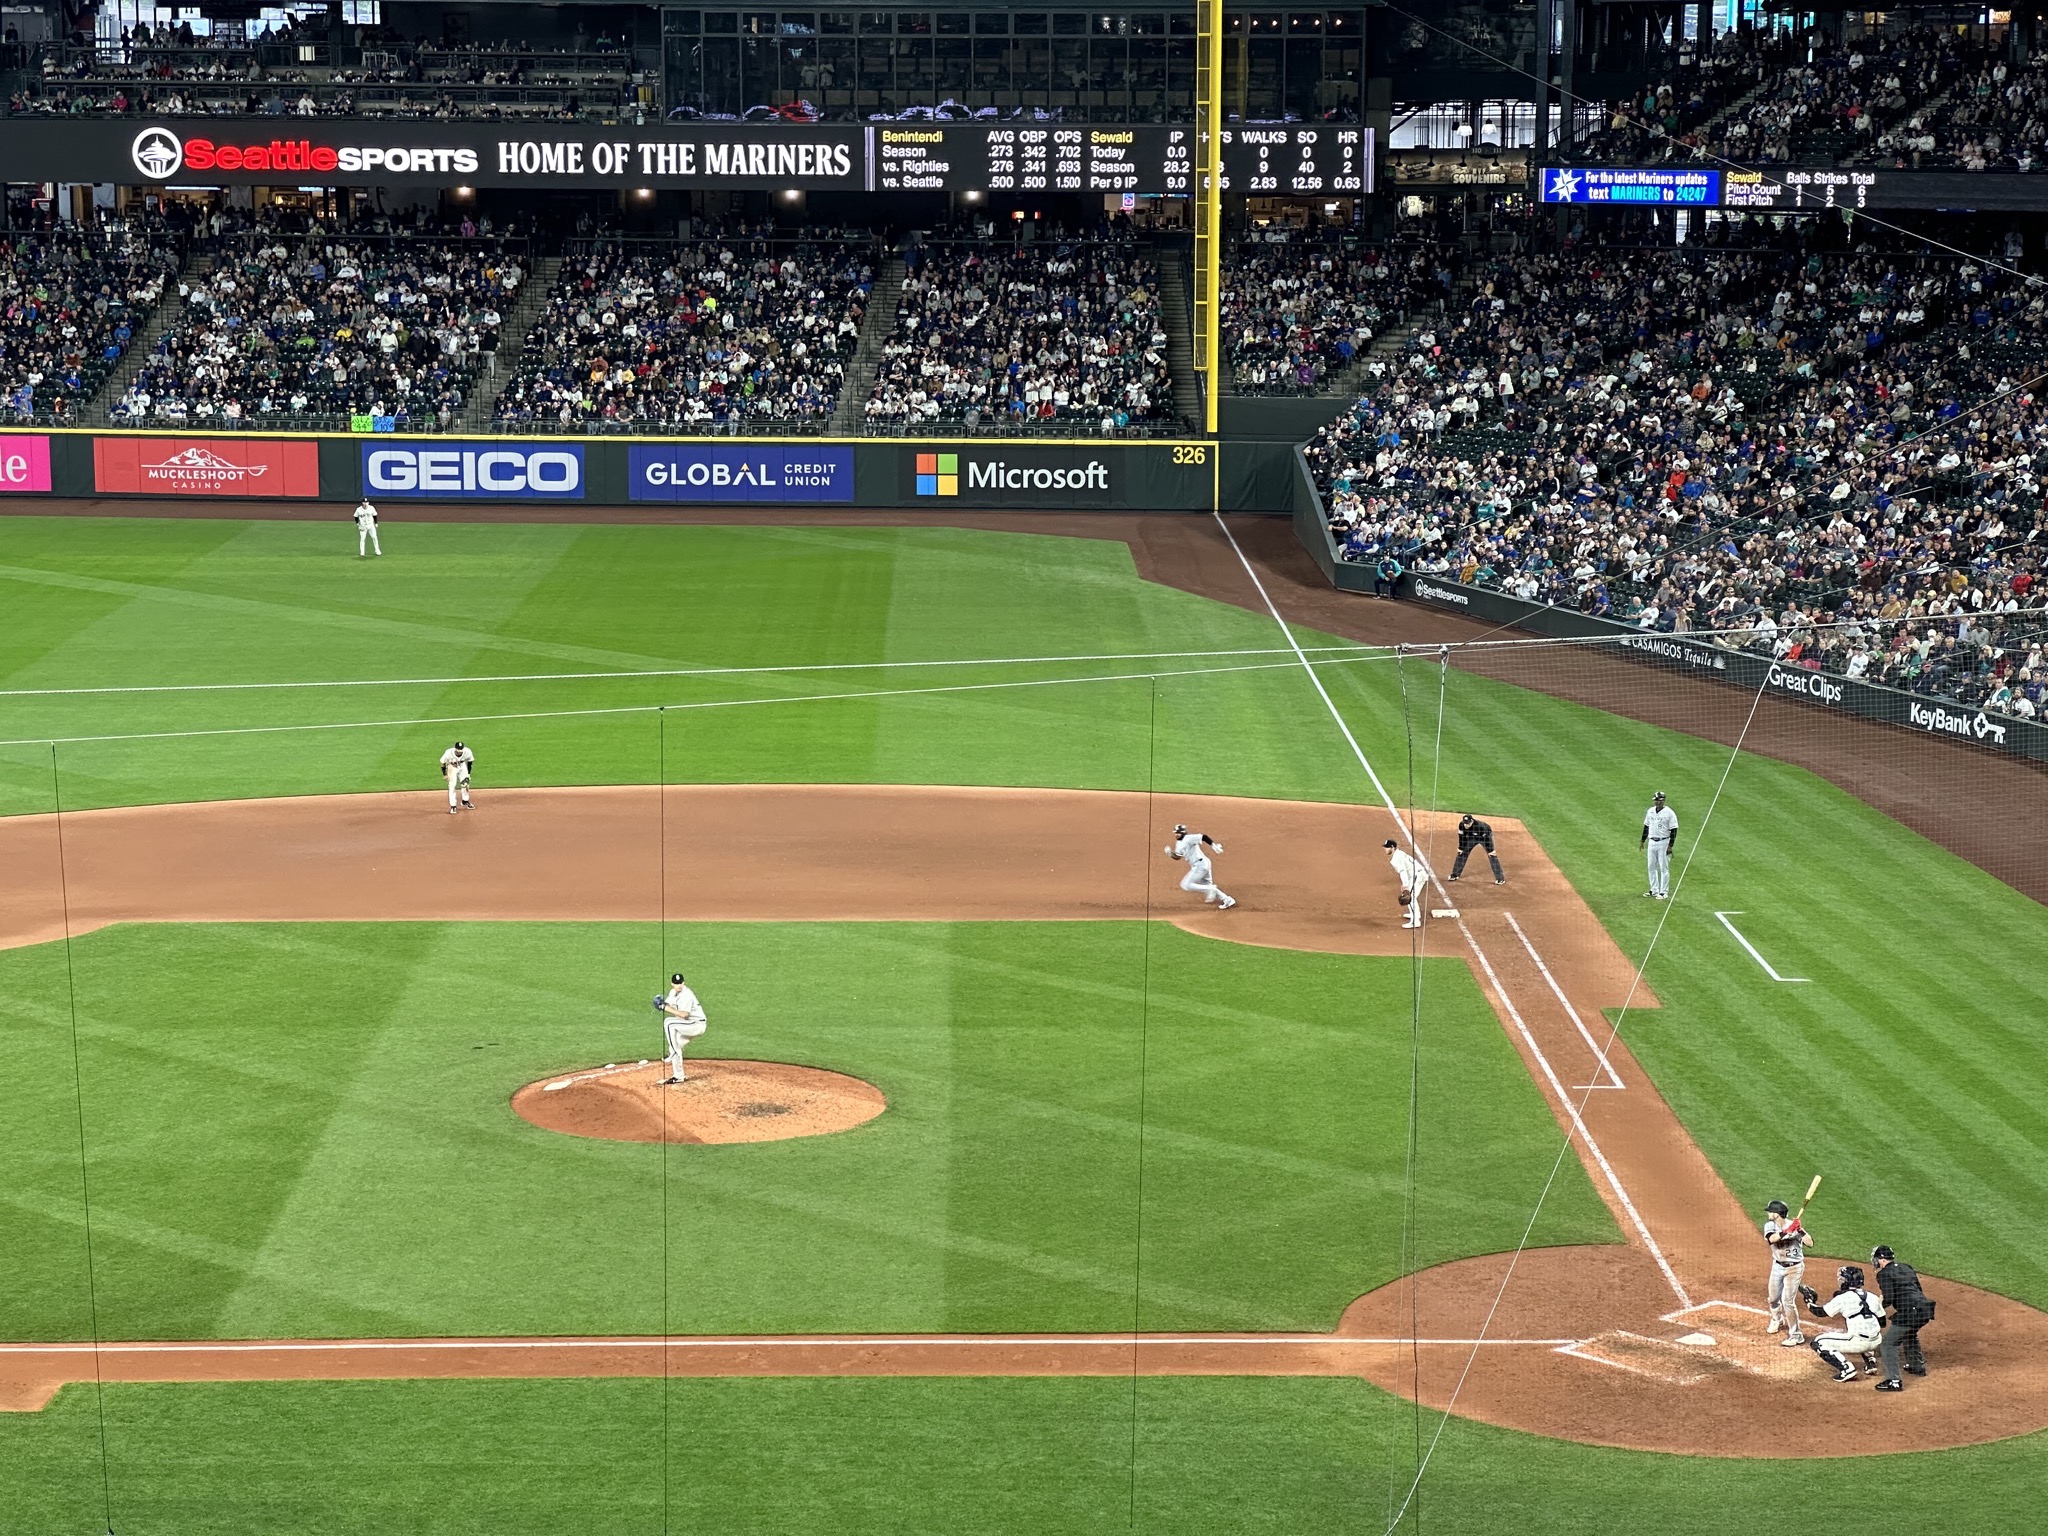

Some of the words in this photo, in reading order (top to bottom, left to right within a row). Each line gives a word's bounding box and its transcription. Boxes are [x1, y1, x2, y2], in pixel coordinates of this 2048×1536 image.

[883, 131, 942, 142] Benintendi
[987, 131, 1014, 142] AVG
[1019, 131, 1047, 143] OBP
[1054, 131, 1081, 143] OPS
[1091, 131, 1132, 143] Sewald
[1170, 131, 1183, 143] IP
[1202, 131, 1232, 143] HS
[1242, 131, 1287, 143] WALKS
[1297, 131, 1317, 143] SO
[1338, 132, 1357, 143] HR
[883, 145, 926, 157] Season
[988, 145, 1013, 157] .273
[1021, 146, 1046, 157] .342
[1056, 146, 1081, 157] .702
[1090, 146, 1125, 160] Today
[1167, 146, 1186, 158] 0.0
[1260, 146, 1268, 158] 0
[1303, 147, 1311, 158] 0
[1344, 147, 1352, 158] 0
[498, 142, 584, 173] HOME
[592, 143, 630, 174] OF
[638, 144, 696, 174] THE
[705, 144, 850, 176] MARINERS
[883, 162, 899, 172] vs.
[903, 160, 949, 173] Righties
[989, 160, 1014, 172] .276
[1022, 161, 1045, 172] .341
[1056, 161, 1081, 172] .693
[1091, 161, 1134, 172] Season
[1164, 161, 1189, 173] 28.2
[1260, 161, 1268, 173] 9
[1299, 161, 1314, 173] 40
[1343, 161, 1352, 173] 2
[883, 178, 899, 187] vs.
[903, 175, 943, 187] Seattle
[989, 176, 1014, 188] .500
[1021, 176, 1046, 188] .500
[1056, 176, 1081, 188] 1.500
[1091, 176, 1111, 188] Per
[1114, 177, 1122, 188] 9
[1125, 177, 1138, 188] IP
[1167, 177, 1186, 189] 9.0
[1251, 177, 1277, 189] 2.83
[1292, 177, 1322, 189] 12.56
[1334, 177, 1360, 189] 0.63
[1453, 174, 1506, 184] SOUVENIRS
[1586, 172, 1599, 183] For
[1601, 172, 1613, 183] the
[1615, 172, 1636, 184] latest
[1638, 172, 1673, 185] Mariners
[1675, 173, 1707, 187] updates
[1727, 172, 1762, 183] Sewald
[1787, 172, 1811, 184] Balls
[1814, 173, 1848, 185] Strikes
[1851, 173, 1875, 185] Total
[1588, 187, 1609, 200] text
[1611, 186, 1660, 200] MARINERS
[1663, 188, 1674, 201] to
[1676, 187, 1706, 201] 24247
[1726, 184, 1750, 195] Pitch
[1752, 184, 1781, 195] Count
[1796, 185, 1802, 195] 1
[1827, 185, 1834, 196] 5
[1858, 185, 1866, 196] 6
[1725, 195, 1749, 205] First
[1750, 195, 1773, 206] Pitch
[1796, 196, 1802, 206] 1
[1826, 196, 1834, 207] 2
[1858, 197, 1866, 208] 3
[1172, 446, 1206, 465] 326
[149, 470, 244, 480] MUCKLESHOOT
[368, 451, 579, 492] GEICO
[646, 463, 776, 485] GLOBAL
[785, 464, 836, 473] CREDIT
[969, 461, 1108, 488] Microsoft
[785, 477, 829, 485] UNION
[1632, 639, 1681, 659] CASAMIGOS
[1684, 648, 1712, 667] Tequila
[1769, 665, 1807, 694] Great
[1809, 674, 1842, 704] Clips
[1910, 702, 1971, 736] KeyBank
